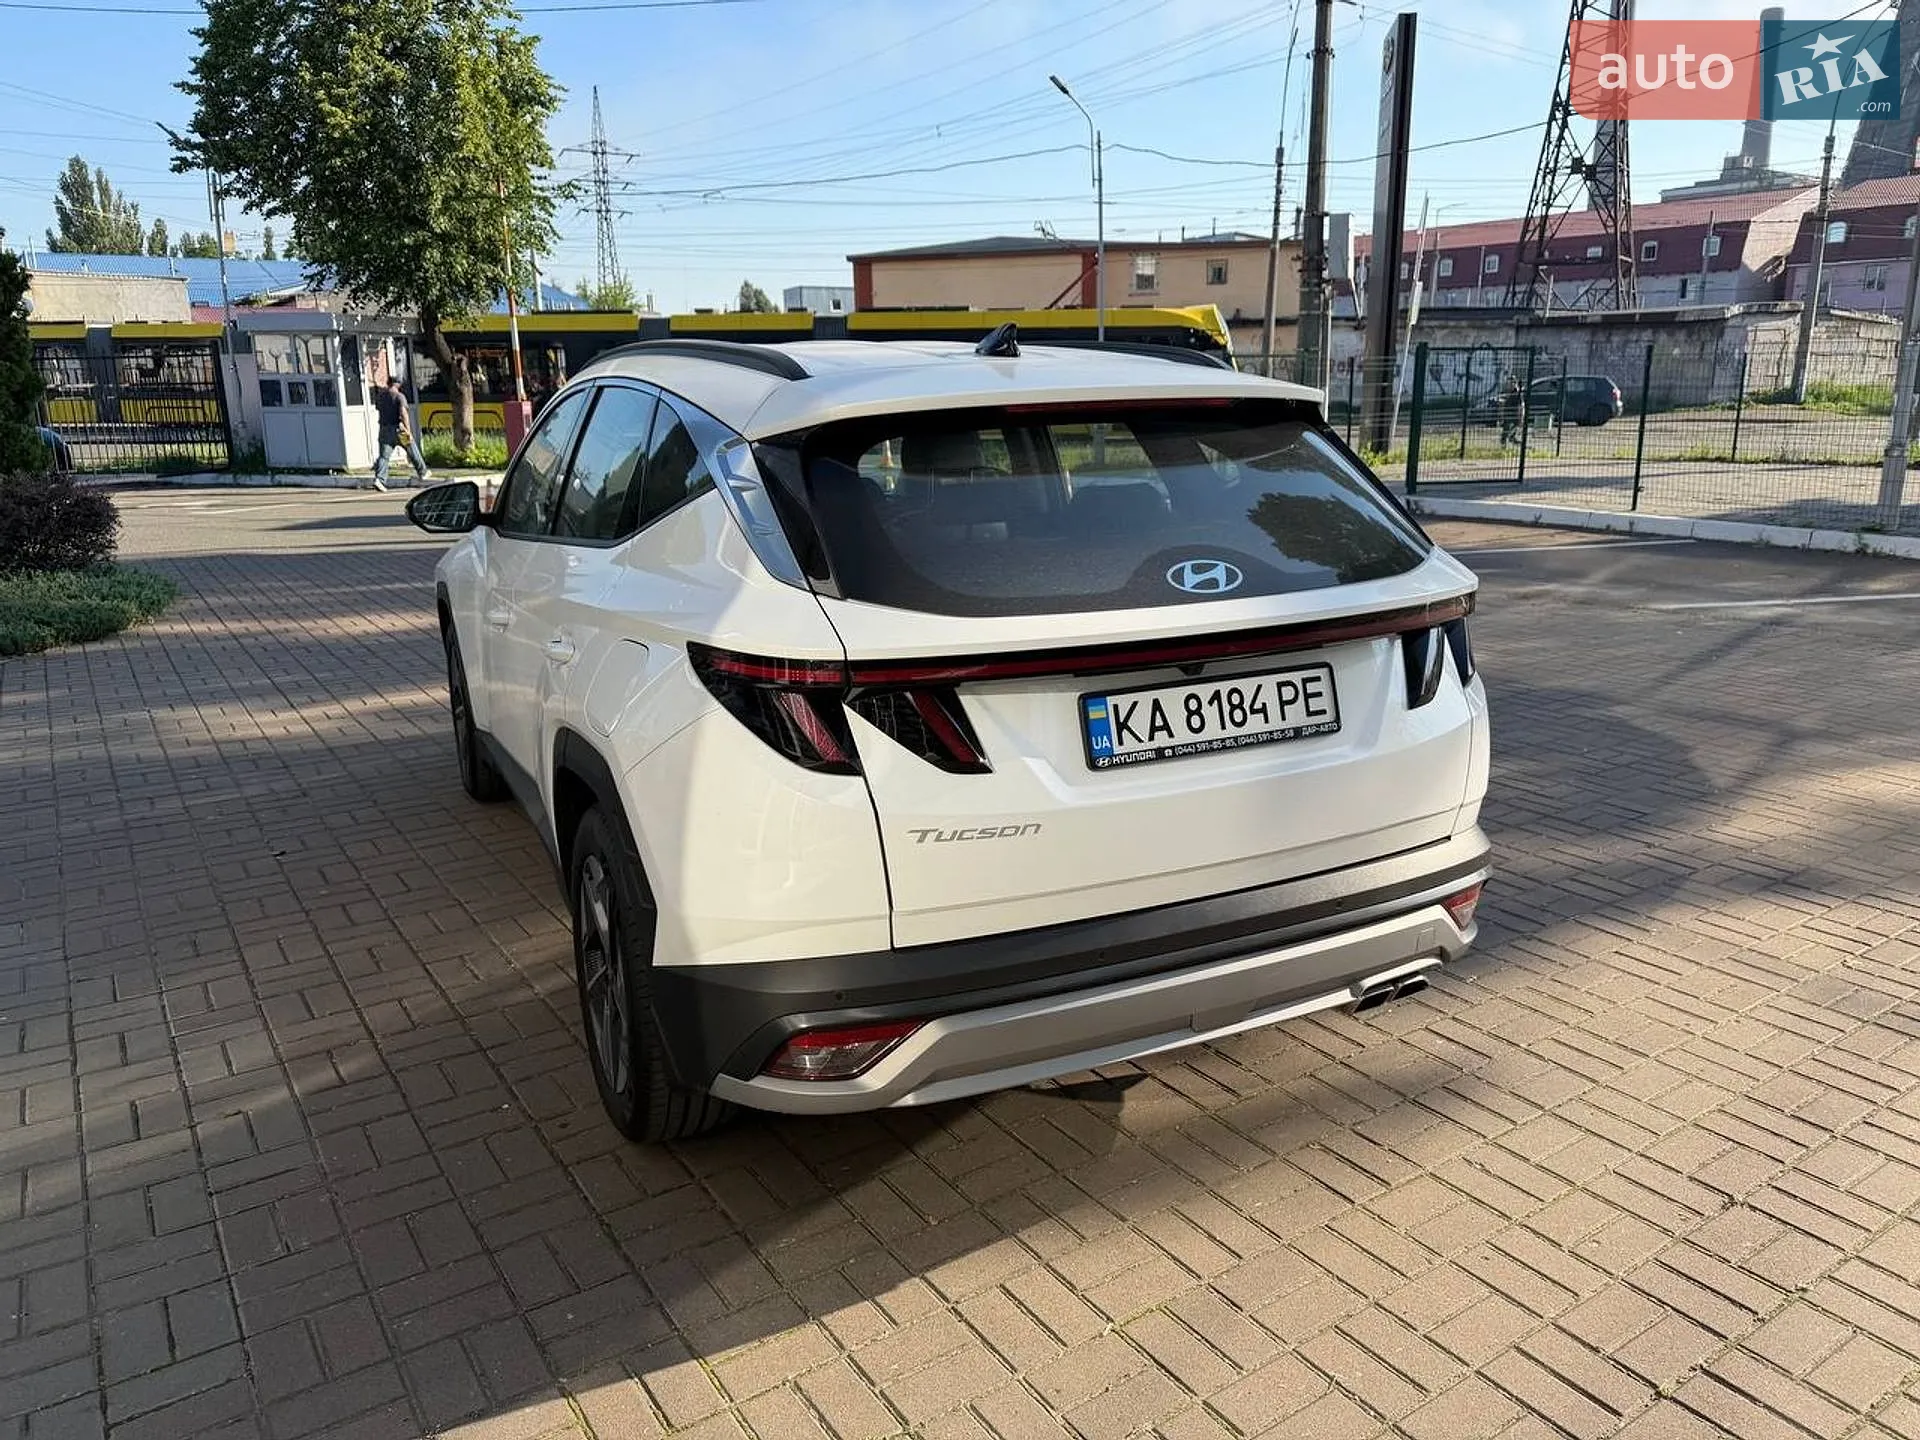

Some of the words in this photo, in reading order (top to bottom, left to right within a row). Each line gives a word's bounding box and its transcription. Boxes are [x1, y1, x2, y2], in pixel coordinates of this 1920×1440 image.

[1112, 698, 1175, 746] KA
[1183, 684, 1270, 735] 8184
[1276, 675, 1327, 722] PE
[1092, 735, 1111, 749] UA
[1112, 750, 1156, 765] HYUNDAI
